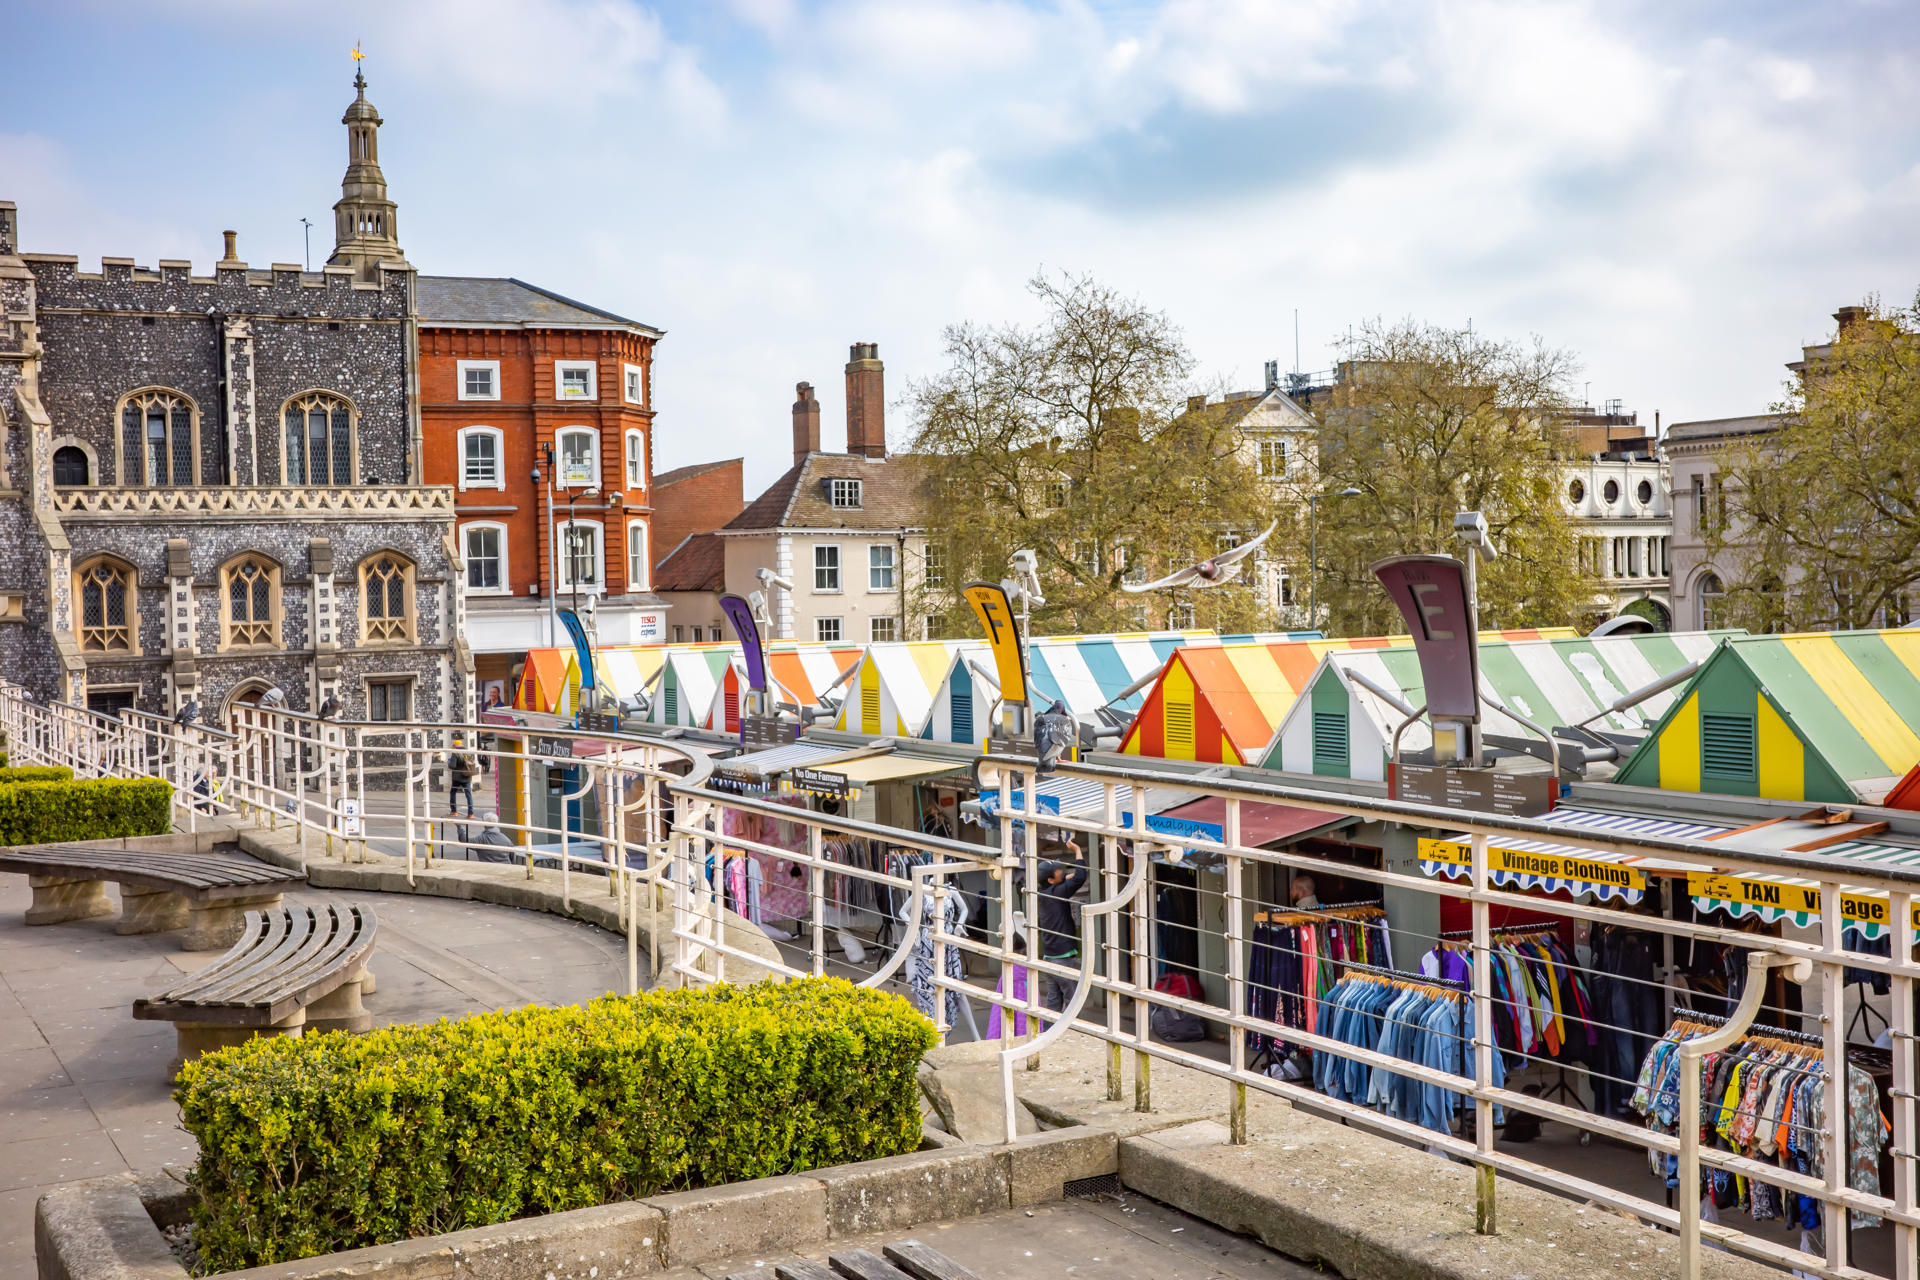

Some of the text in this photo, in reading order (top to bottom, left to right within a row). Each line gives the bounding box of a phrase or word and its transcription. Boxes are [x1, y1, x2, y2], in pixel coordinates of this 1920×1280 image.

[640, 615, 657, 624] TESCO
[981, 602, 1004, 645] F
[1407, 584, 1455, 641] E
[566, 621, 586, 650] H
[795, 768, 804, 778] No
[804, 769, 818, 780] One
[1457, 846, 1631, 887] TA Vintage Clothing
[1741, 881, 1780, 904] TAXI
[1803, 890, 1884, 920] Vitage
